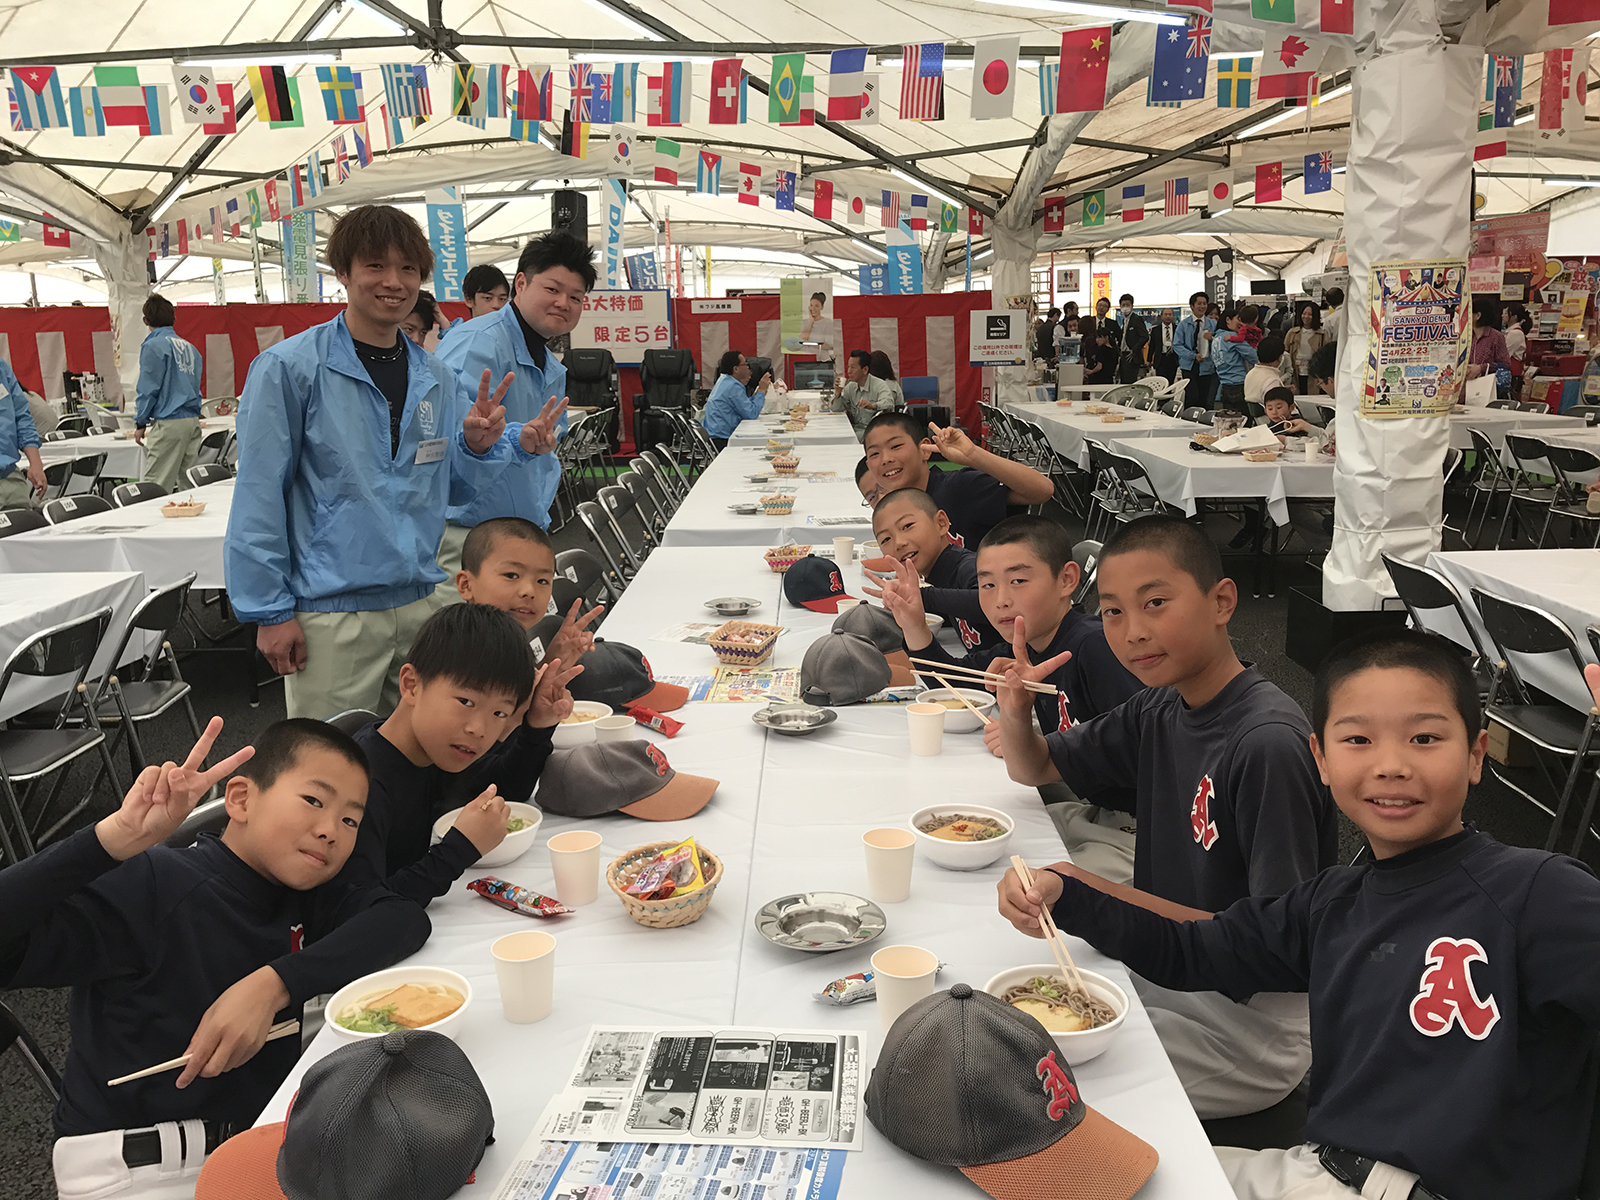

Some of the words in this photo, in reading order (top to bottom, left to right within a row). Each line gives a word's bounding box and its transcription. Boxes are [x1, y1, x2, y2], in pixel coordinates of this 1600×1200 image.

[1216, 276, 1228, 314] Tetra
[1416, 306, 1432, 314] 2017
[594, 325, 669, 343] 限定5台
[1383, 323, 1459, 341] FESTIVAL
[1394, 316, 1427, 325] SANKYO
[1428, 315, 1450, 324] DENKI
[828, 571, 843, 592] A
[645, 742, 671, 777] A
[1190, 773, 1220, 852] A
[1408, 936, 1501, 1041] A
[1035, 1050, 1079, 1121] A
[797, 1098, 810, 1136] GH-BEERJ-BK
